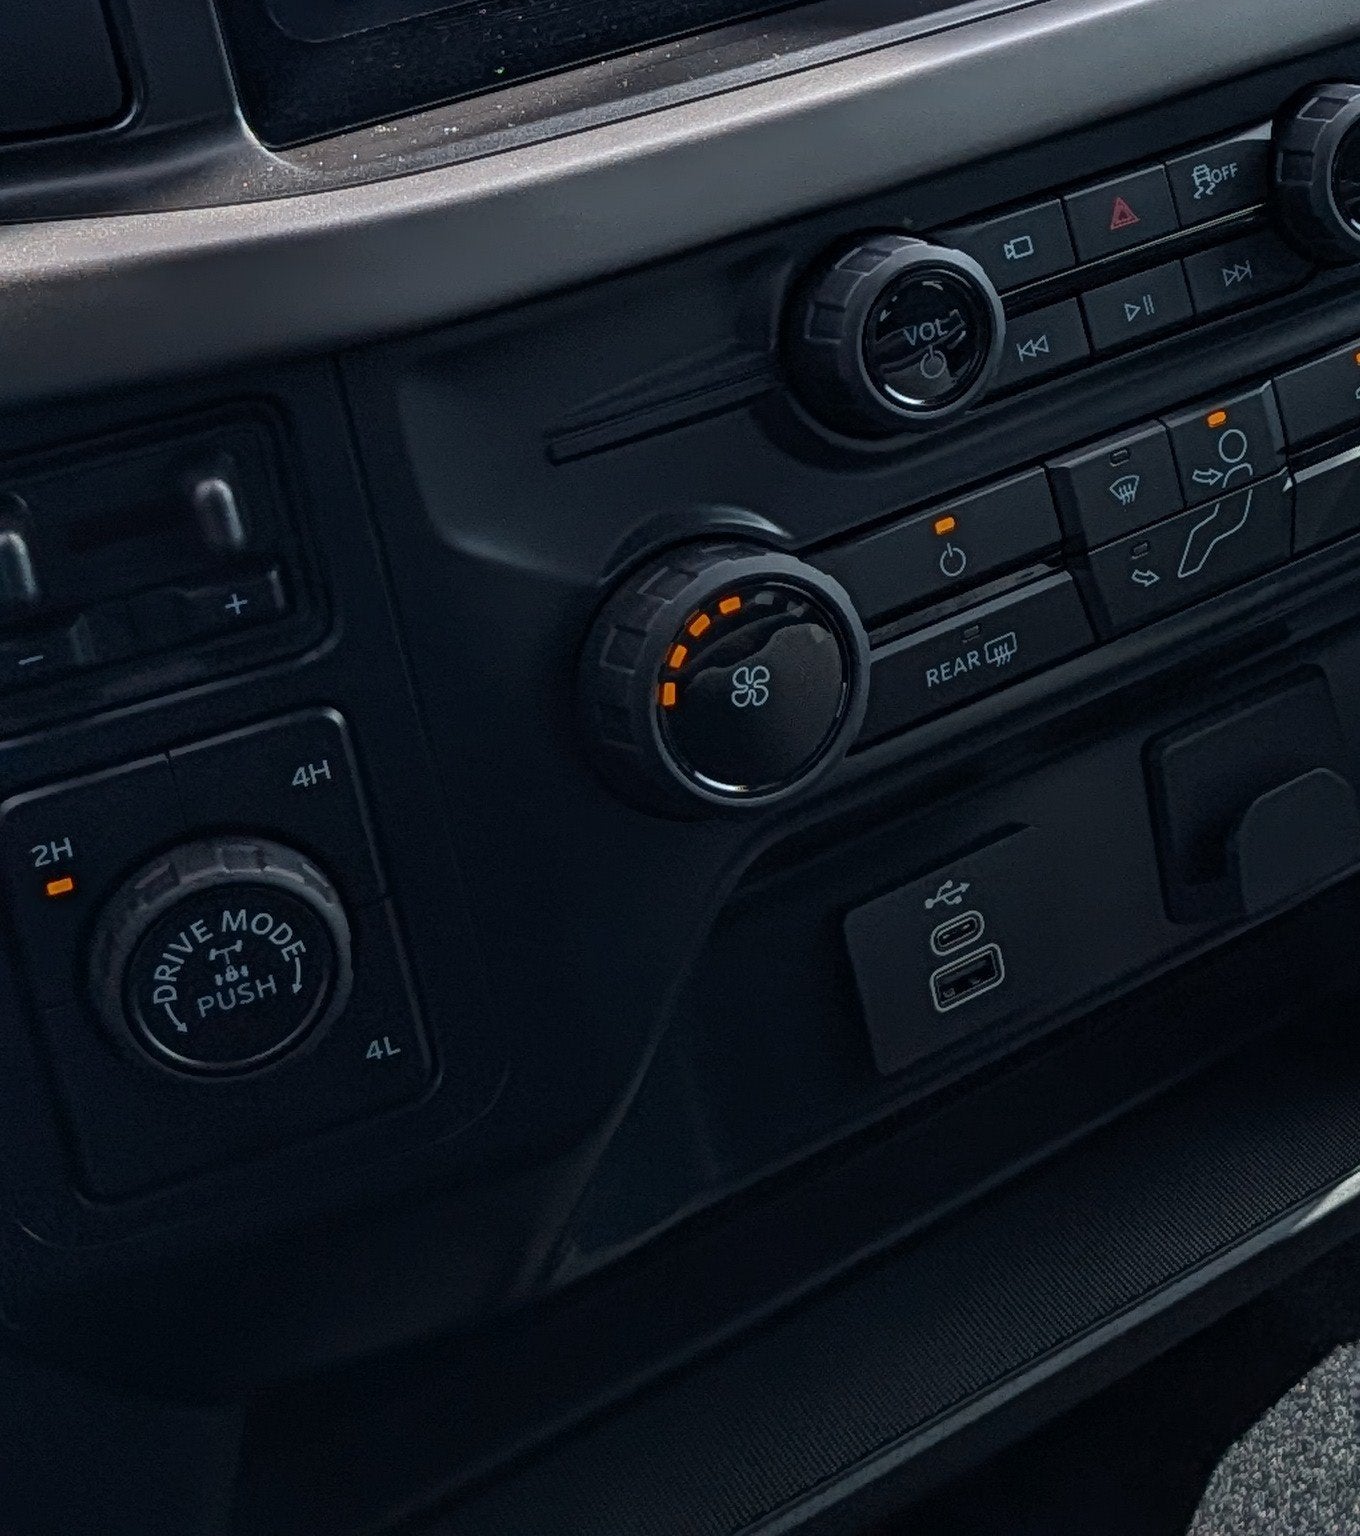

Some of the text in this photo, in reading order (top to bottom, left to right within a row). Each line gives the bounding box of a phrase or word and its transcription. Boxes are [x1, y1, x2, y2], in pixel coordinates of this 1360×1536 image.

[1211, 162, 1237, 183] OFF
[903, 321, 947, 347] VOL
[925, 651, 981, 687] REAR
[290, 760, 332, 789] 4H
[30, 836, 74, 867] 2H
[153, 909, 307, 1005] DRIVE MODE
[197, 974, 278, 1017] PUSH
[365, 1035, 401, 1061] 4L
